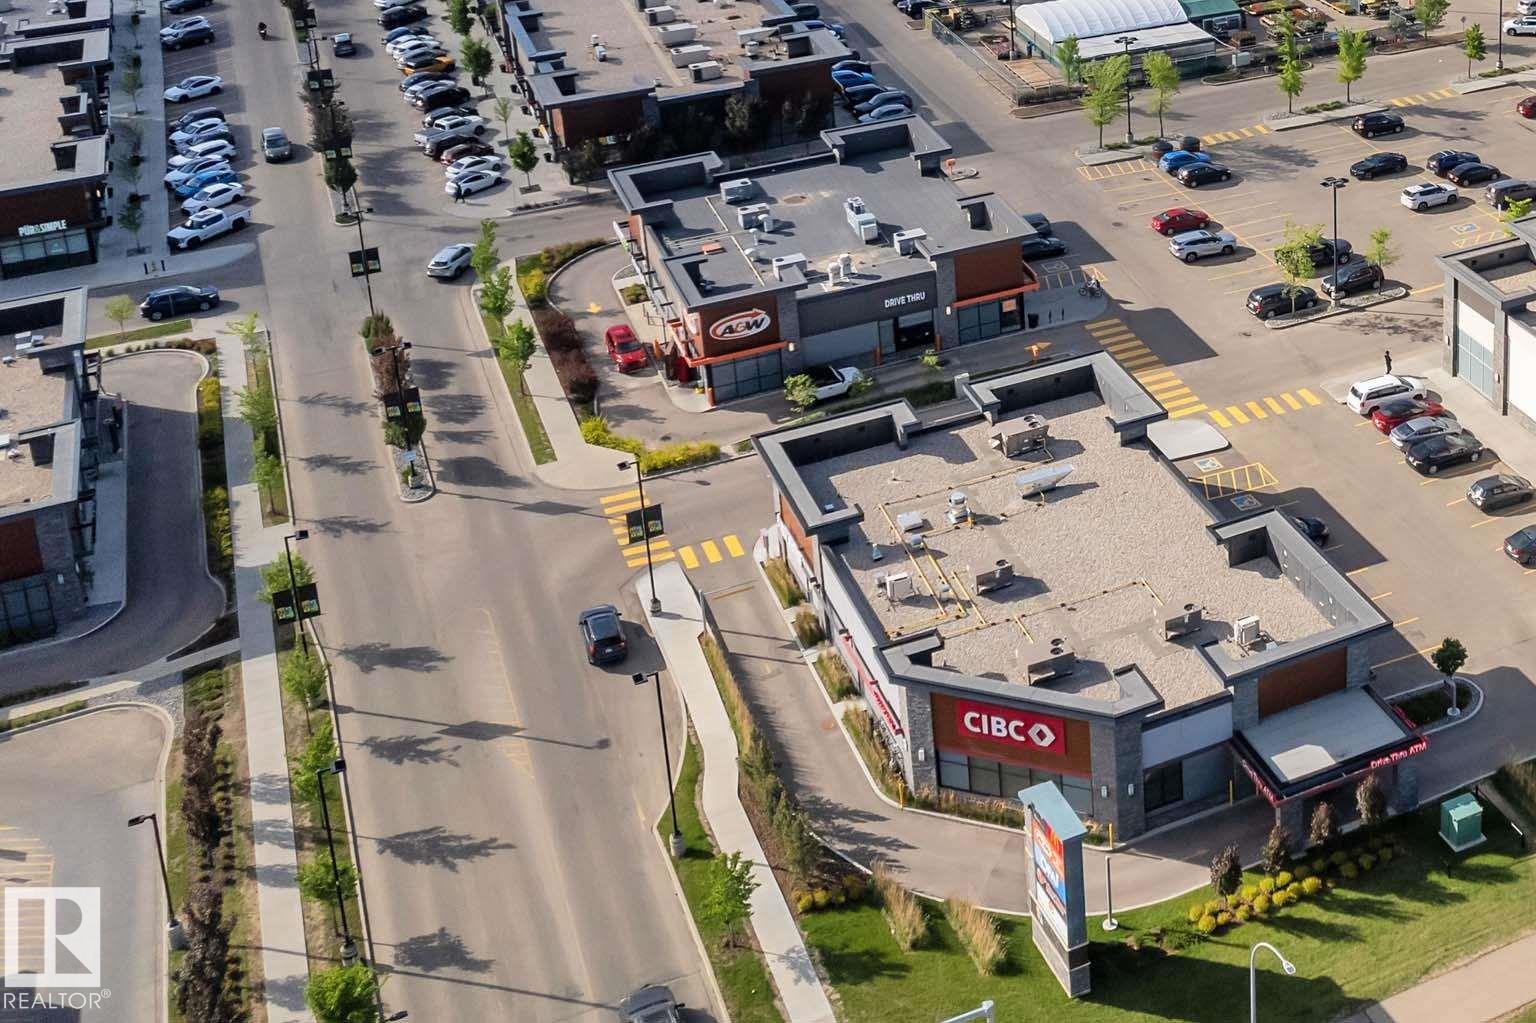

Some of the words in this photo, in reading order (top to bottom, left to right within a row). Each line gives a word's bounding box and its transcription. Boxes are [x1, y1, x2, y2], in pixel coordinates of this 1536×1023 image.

[884, 295, 906, 309] DRIVE
[906, 291, 926, 304] THRU
[721, 317, 765, 337] A&W
[963, 711, 1026, 742] CIBC
[1409, 741, 1427, 754] ATM
